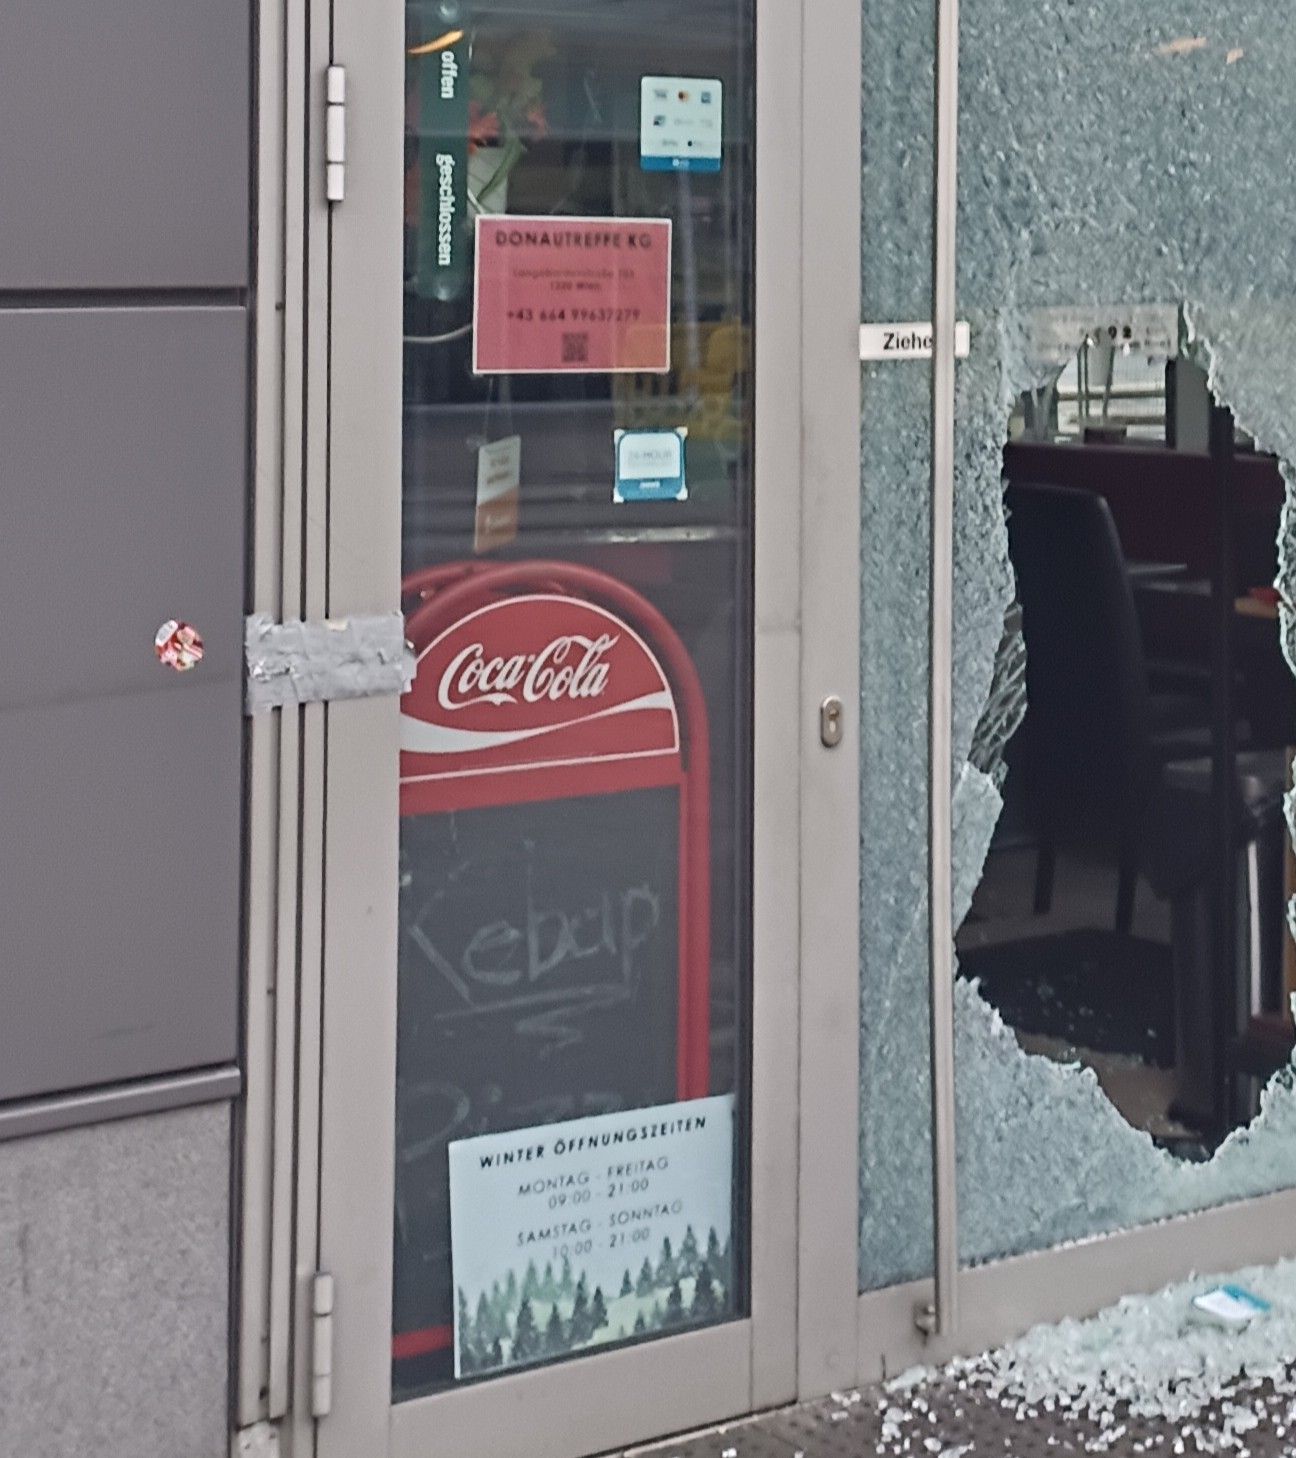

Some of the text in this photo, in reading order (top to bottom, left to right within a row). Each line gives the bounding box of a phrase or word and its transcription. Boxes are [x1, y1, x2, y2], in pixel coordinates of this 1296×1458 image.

[441, 51, 458, 98] offen
[436, 154, 456, 266] geschlossen
[628, 233, 652, 248] KG
[883, 331, 932, 351] Ziehe
[438, 633, 620, 710] Coca-Cola
[480, 1116, 706, 1170] WINTER ÖFFNUNGSZEITEN
[519, 1156, 669, 1195] MONTAG FREITAG
[517, 1201, 683, 1247] SAMSTAG SONNTAG
